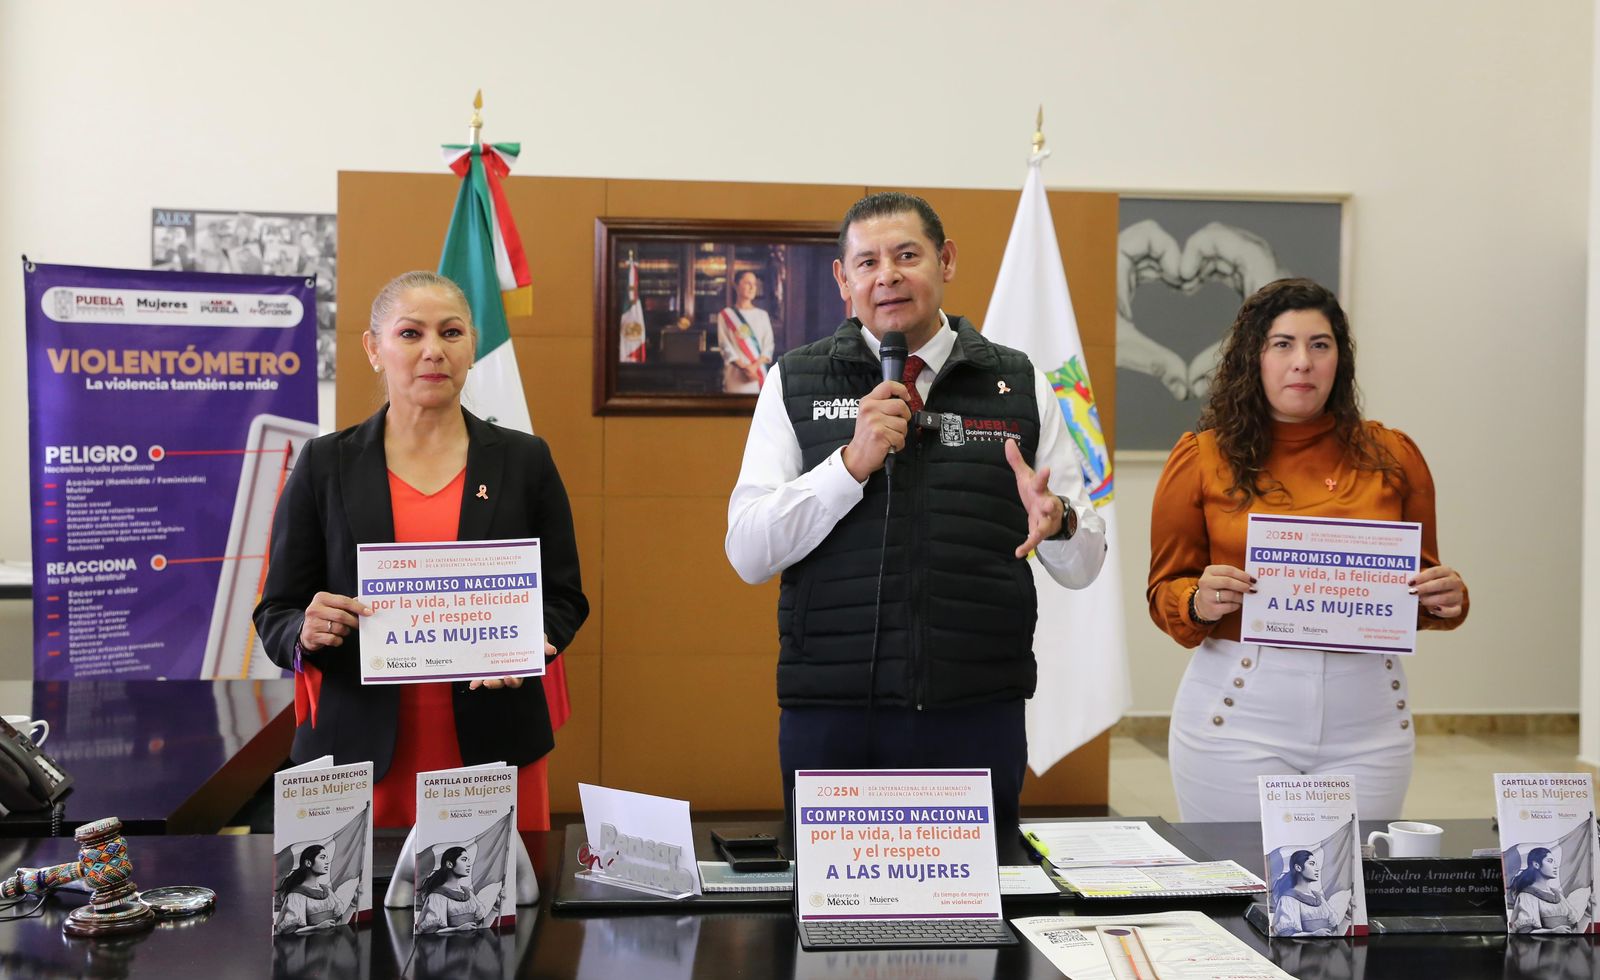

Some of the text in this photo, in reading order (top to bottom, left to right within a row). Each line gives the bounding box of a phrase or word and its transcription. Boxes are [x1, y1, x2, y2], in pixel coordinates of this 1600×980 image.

[76, 295, 124, 306] PUEBLA
[137, 298, 188, 310] Mujeres
[47, 345, 301, 375] VIOLENTÓMETRO
[86, 377, 279, 391] La violencia también se mide
[831, 398, 859, 407] AMO
[813, 407, 859, 420] PUEB
[964, 419, 1020, 432] PUEBLA
[1003, 431, 1021, 440] Estado
[45, 445, 138, 465] PELIGRO
[44, 463, 155, 474] Necesitas ayuda profesional
[66, 477, 104, 487] Asesinar
[1265, 530, 1303, 541] 2025N
[377, 559, 417, 570] 2025N
[1254, 550, 1412, 569] COMPROMISO NACIONAL
[47, 558, 137, 576] REACCIONA
[47, 573, 127, 585] No te dejes destruir
[1257, 566, 1407, 585] por la vida, la felicidad
[367, 575, 533, 593] COMPROMISO NACIONAL
[1292, 583, 1370, 598] y el respeto
[68, 589, 105, 598] Encerrar
[114, 586, 138, 595] aislar
[371, 591, 529, 613] por la vida, la felicidad
[1267, 597, 1393, 618] A LAS MUJERES
[411, 610, 492, 627] y el respeto
[385, 625, 519, 645] A LAS MUJERES
[1266, 624, 1294, 633] México
[386, 661, 417, 669] México
[282, 776, 319, 786] CARTILLA
[332, 770, 368, 780] DERECHOS
[424, 778, 461, 786] CARTILLA
[474, 773, 512, 783] DERECHOS
[282, 781, 367, 799] de las Mujeres
[425, 784, 511, 799] de las Mujeres
[817, 786, 859, 797] 2025N
[1267, 790, 1351, 803] de las Mujeres
[1503, 788, 1588, 800] de las Mujeres
[308, 809, 331, 817] México
[806, 809, 984, 822] COMPROMISO NACIONAL
[811, 826, 981, 844] por la vida, la felicidad
[853, 844, 941, 861] y el respeto
[826, 863, 971, 883] A LAS MUJERES
[1424, 869, 1476, 880] Armenta
[1406, 886, 1420, 894] del
[1422, 885, 1452, 894] Estado
[1454, 885, 1466, 893] de
[1468, 885, 1499, 893] Puebla
[827, 897, 860, 906] México
[869, 896, 899, 904] Mujeres
